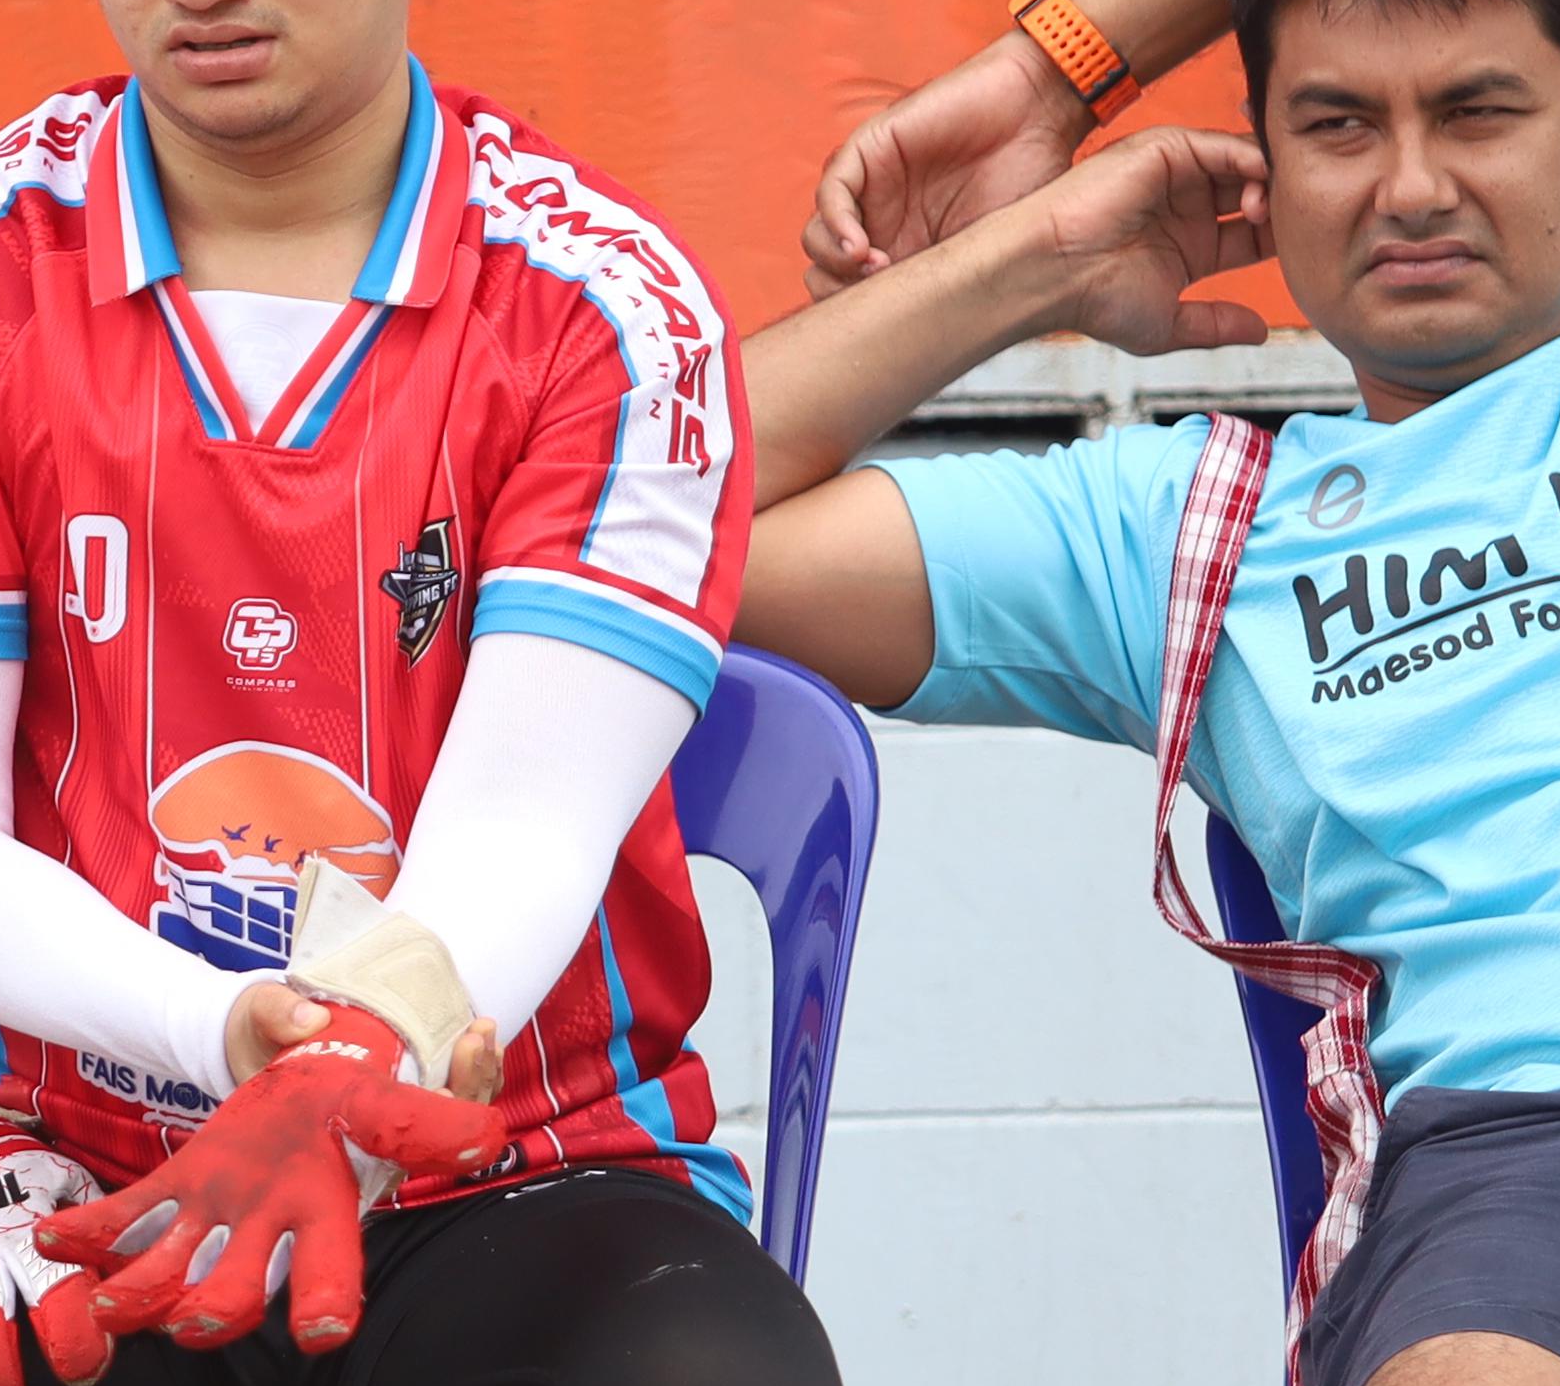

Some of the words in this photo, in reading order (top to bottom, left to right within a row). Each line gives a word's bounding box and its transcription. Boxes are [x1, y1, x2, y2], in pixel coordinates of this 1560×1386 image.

[1292, 534, 1529, 664] HIM
[225, 676, 297, 689] COMPASS
[1311, 612, 1493, 704] Maesod
[81, 1050, 138, 1095] FAIS
